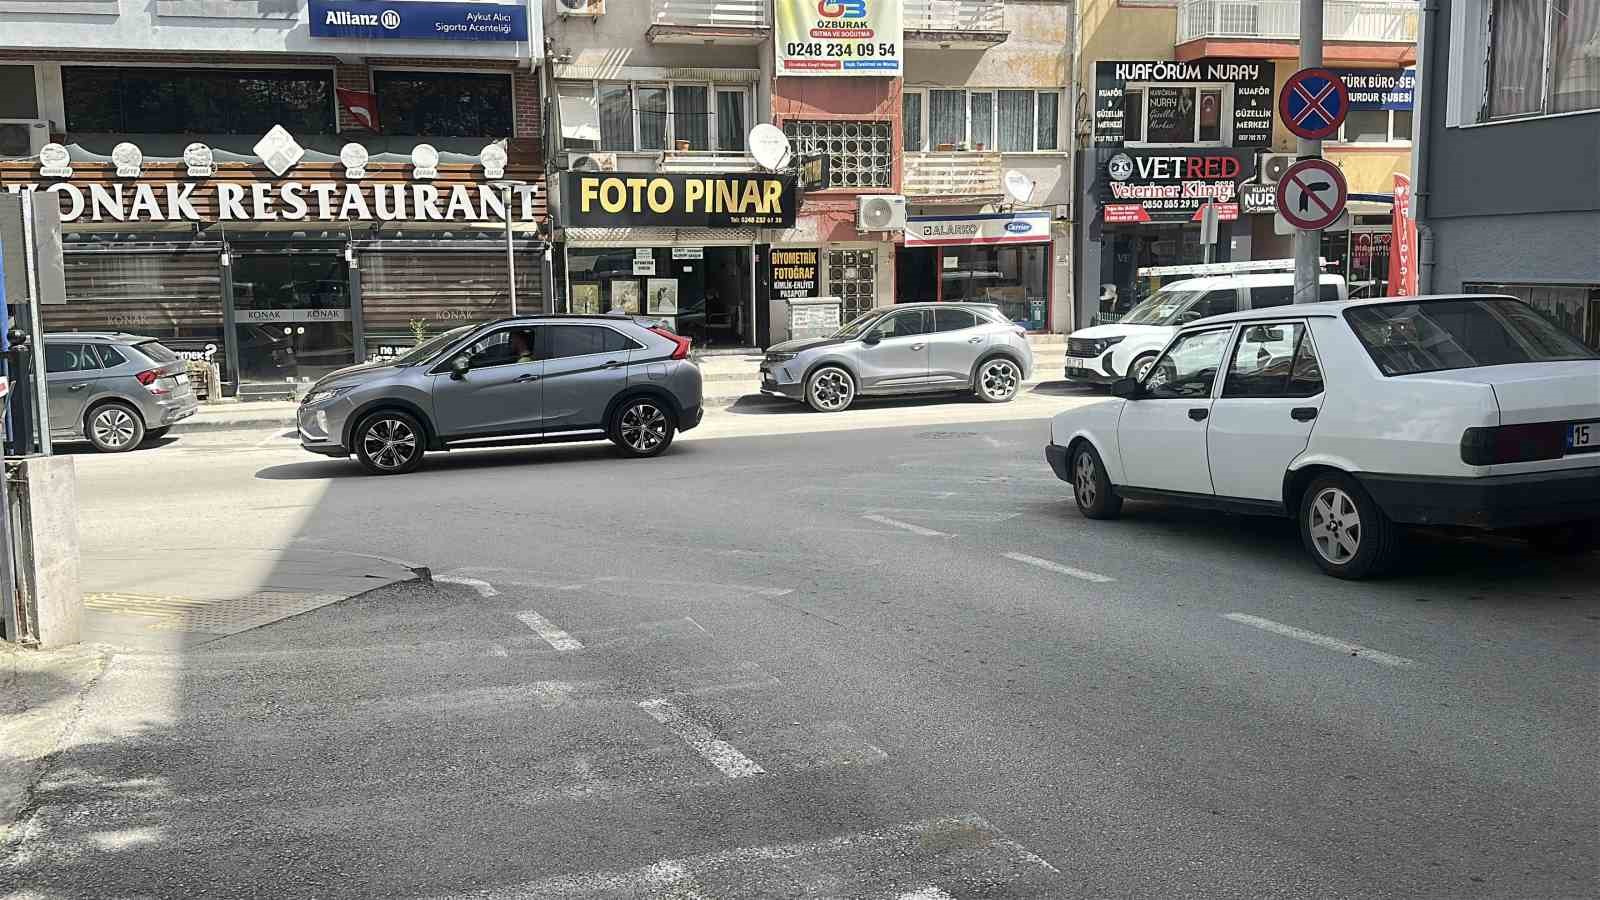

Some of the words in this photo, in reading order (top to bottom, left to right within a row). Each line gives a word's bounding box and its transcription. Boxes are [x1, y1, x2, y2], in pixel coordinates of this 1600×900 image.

[326, 11, 378, 25] Allianz
[467, 12, 491, 22] Aykut
[435, 22, 467, 32] Sigorta
[469, 23, 511, 34] Acenteliği
[817, 20, 868, 29] ÖZBURAK
[787, 42, 822, 56] 0248
[826, 42, 853, 56] 234
[857, 42, 874, 56] 09
[879, 42, 895, 56] 54
[1115, 61, 1201, 80] KUAFÖRÜM
[1208, 64, 1258, 81] NURAY
[1340, 73, 1369, 88] TÜRK
[1098, 87, 1123, 97] KUAFÖR
[1238, 86, 1270, 95] KUAFÖR
[1251, 98, 1256, 106] &
[1348, 92, 1379, 102] URDUR
[1381, 90, 1412, 104] ŞUBESİ
[1150, 98, 1177, 107] NURAY
[1096, 109, 1124, 118] GÜZELLİK
[1235, 108, 1271, 118] GÜZELLİK
[1236, 120, 1270, 129] MERKEZİ
[1136, 156, 1242, 179] VETRED
[581, 177, 674, 214] FOTO
[685, 178, 783, 214] PINAR
[1110, 180, 1180, 199] Veteriner
[1182, 180, 1235, 203] Kliniği
[7, 182, 200, 222] ONAK
[217, 182, 538, 221] RESTAURANT
[1142, 199, 1163, 209] 0850
[1006, 222, 1031, 233] Carrier
[771, 250, 817, 265] BİYOMETRİK
[774, 265, 814, 280] FOTOĞRAF
[780, 289, 808, 298] PASAPORT
[248, 311, 281, 319] KONAK
[307, 310, 340, 319] KONAK
[436, 310, 473, 320] KONAK
[1575, 426, 1590, 445] 15
